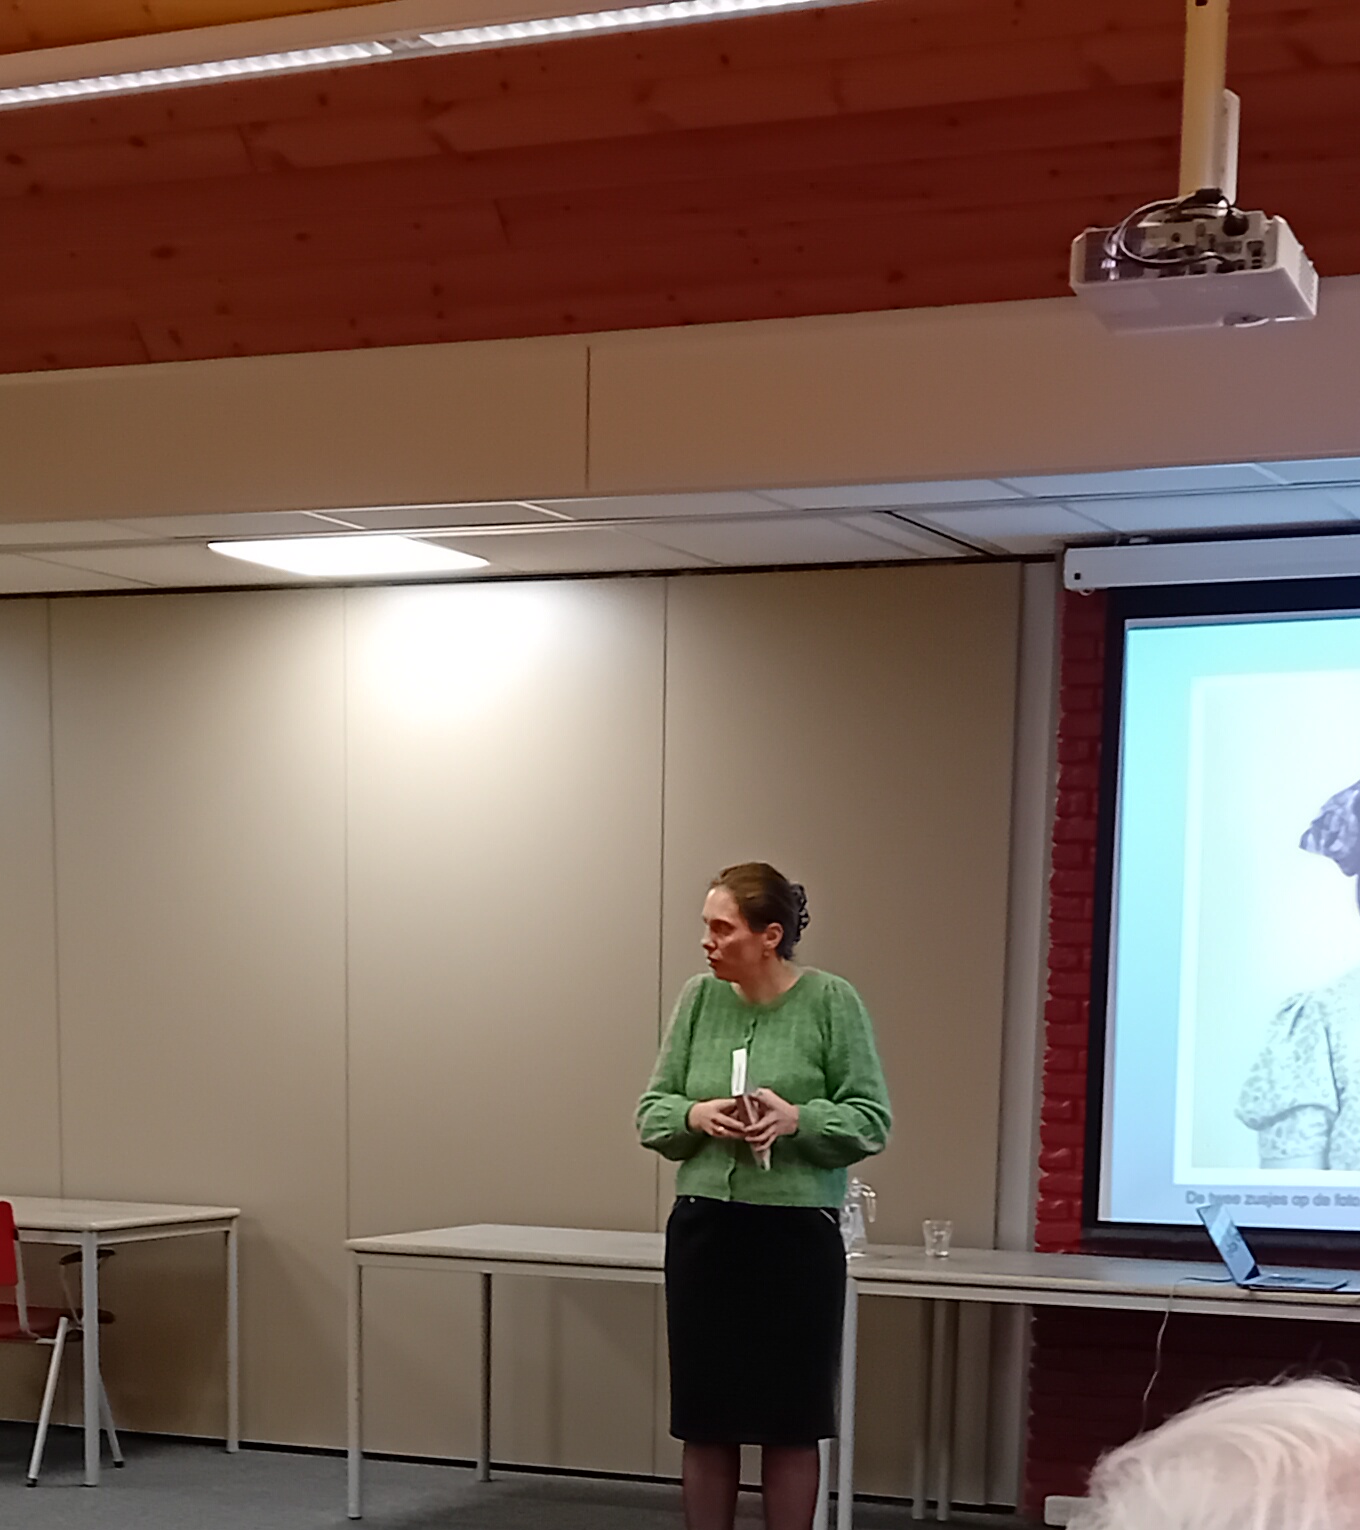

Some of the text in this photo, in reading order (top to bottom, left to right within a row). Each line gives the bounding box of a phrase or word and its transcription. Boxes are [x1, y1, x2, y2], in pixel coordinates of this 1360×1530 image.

[1186, 1191, 1205, 1205] De
[1244, 1193, 1288, 1209] zusjes
[1292, 1194, 1310, 1209] op
[1312, 1193, 1331, 1207] de
